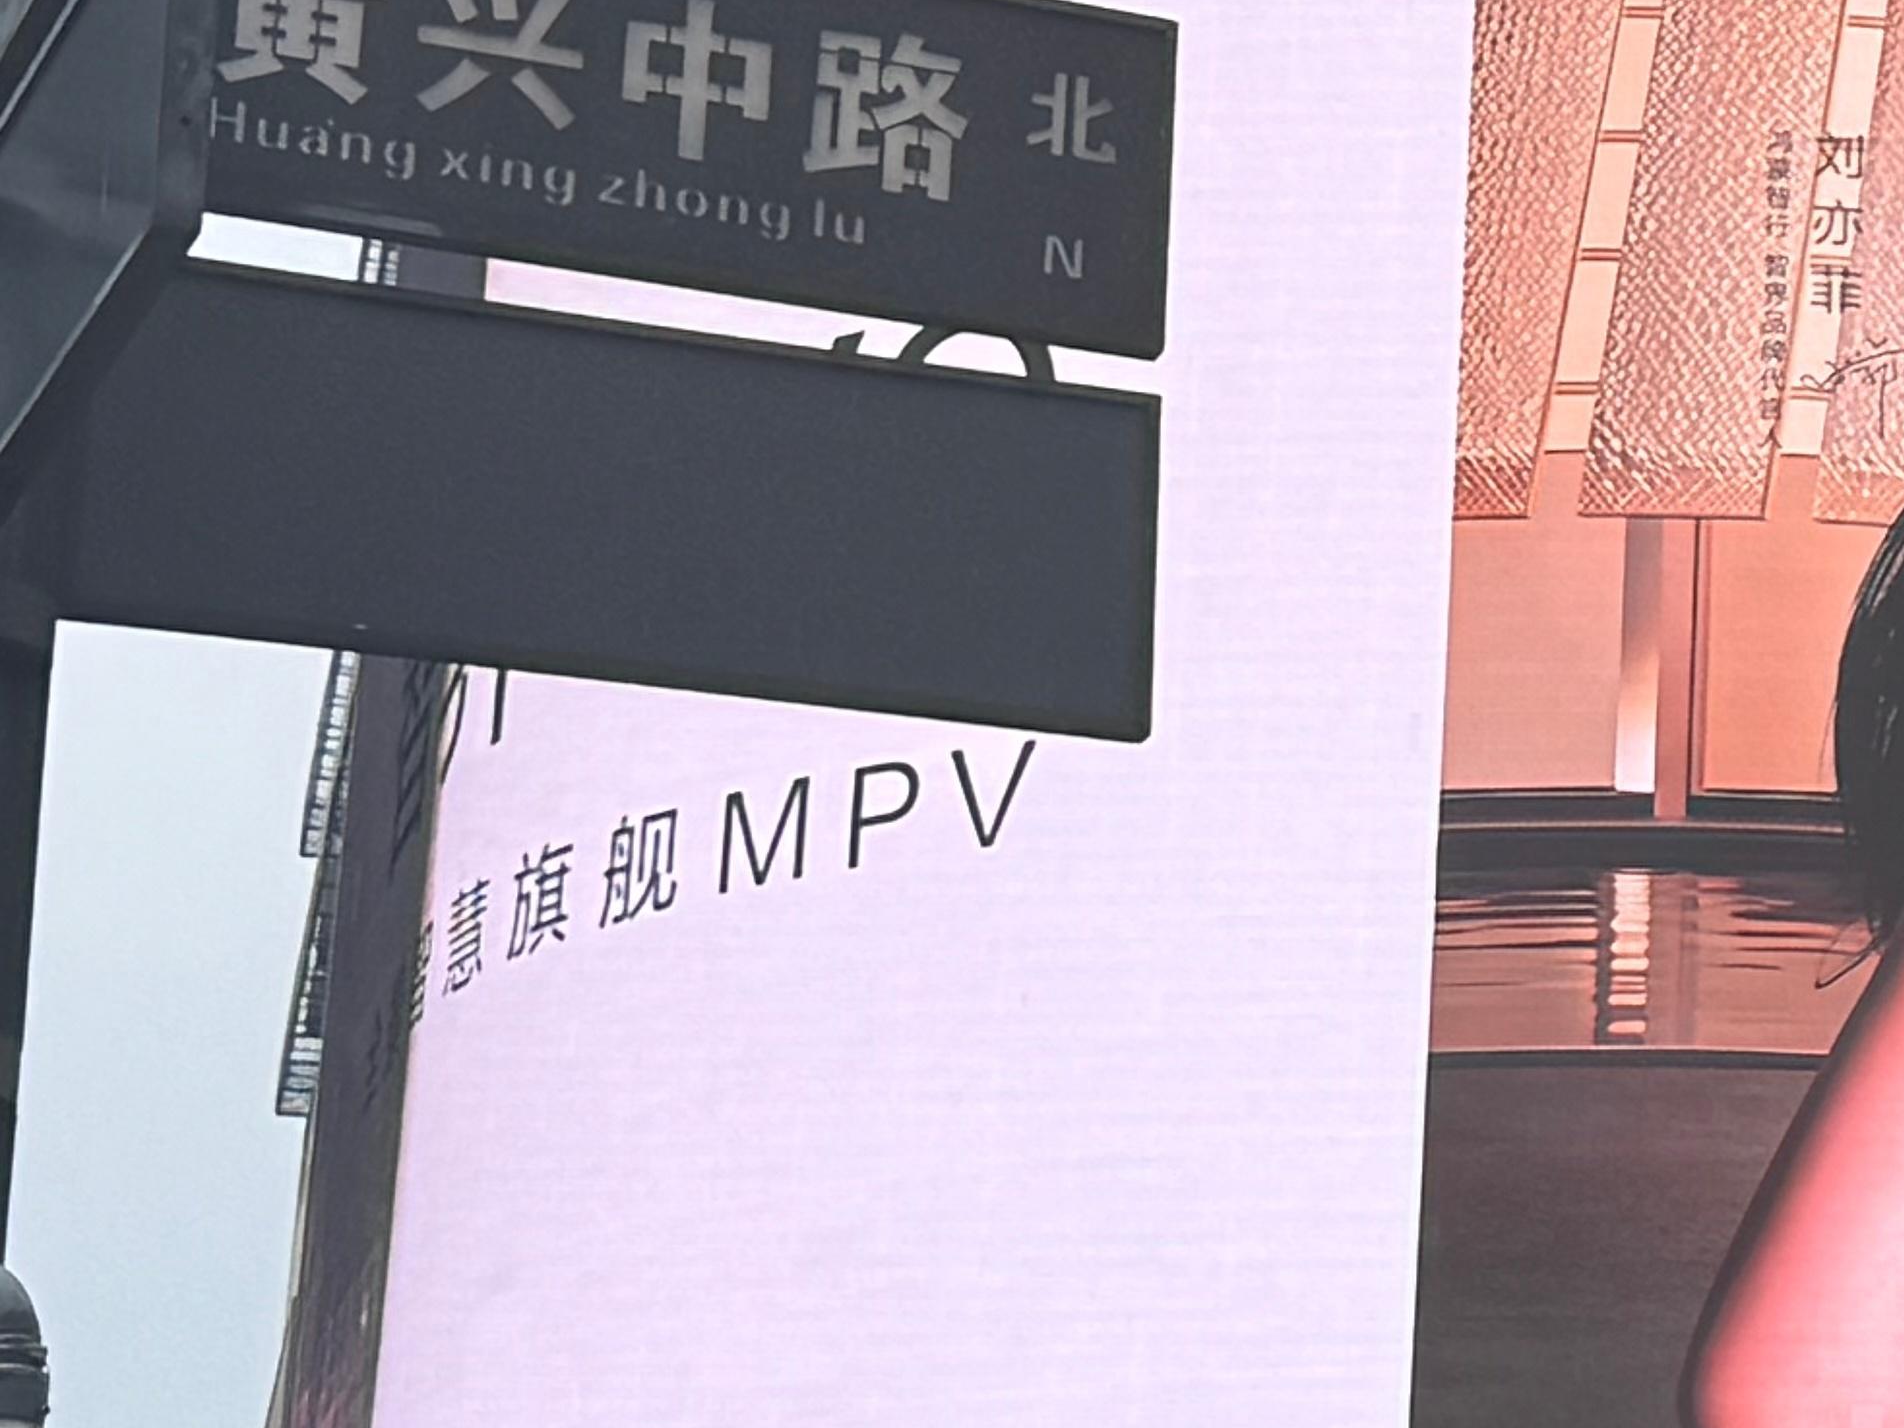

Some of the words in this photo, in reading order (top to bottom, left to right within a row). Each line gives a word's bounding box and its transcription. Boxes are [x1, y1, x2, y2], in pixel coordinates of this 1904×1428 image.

[1026, 71, 1117, 164] 北
[439, 144, 577, 207] xing
[597, 172, 791, 243] zhong
[810, 199, 868, 246] lu
[1808, 133, 1867, 315] 刘亦菲
[1042, 234, 1086, 280] N
[718, 738, 1037, 895] MPV
